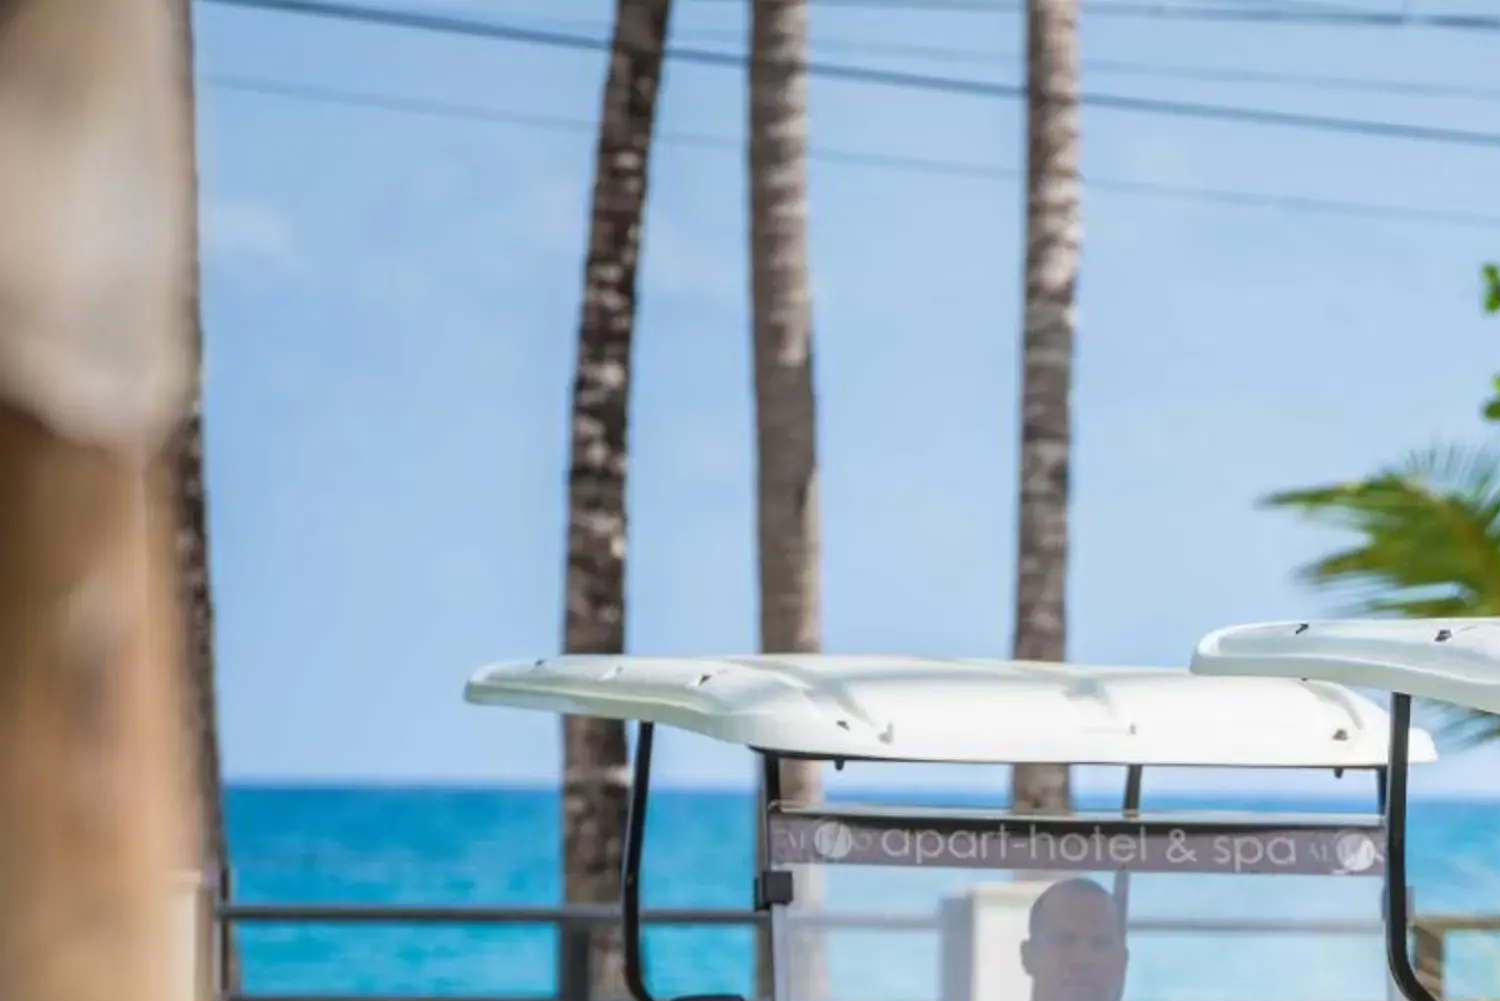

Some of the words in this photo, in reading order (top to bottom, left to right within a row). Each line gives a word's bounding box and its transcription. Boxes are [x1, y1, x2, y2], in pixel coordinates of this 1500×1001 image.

[881, 823, 1146, 870] apart-hotel
[1166, 829, 1198, 864] &
[1212, 835, 1298, 874] spa
